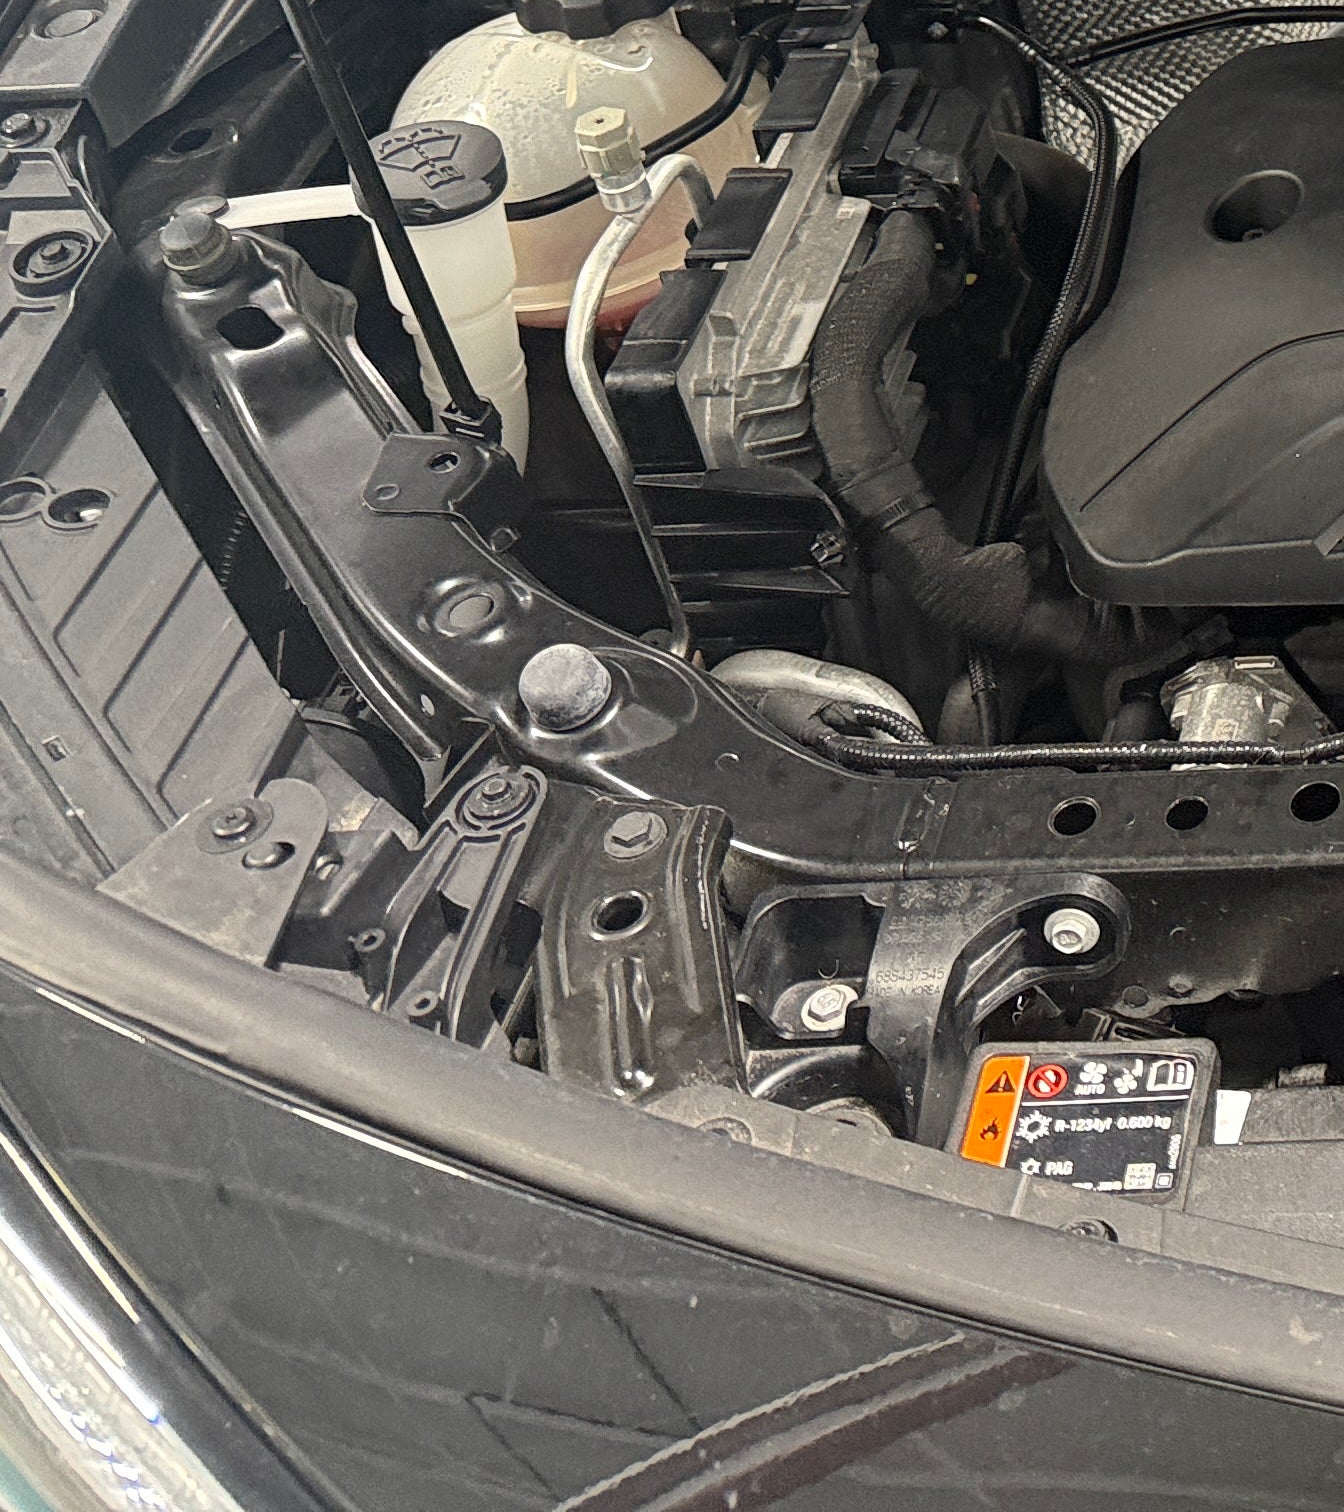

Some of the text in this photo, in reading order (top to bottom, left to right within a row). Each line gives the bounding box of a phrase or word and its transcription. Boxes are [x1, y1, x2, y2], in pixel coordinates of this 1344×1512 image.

[1074, 1084, 1106, 1096] AUTO
[1053, 1114, 1172, 1133] R-1234yf 0.600 kg
[1045, 1160, 1074, 1176] PAG
